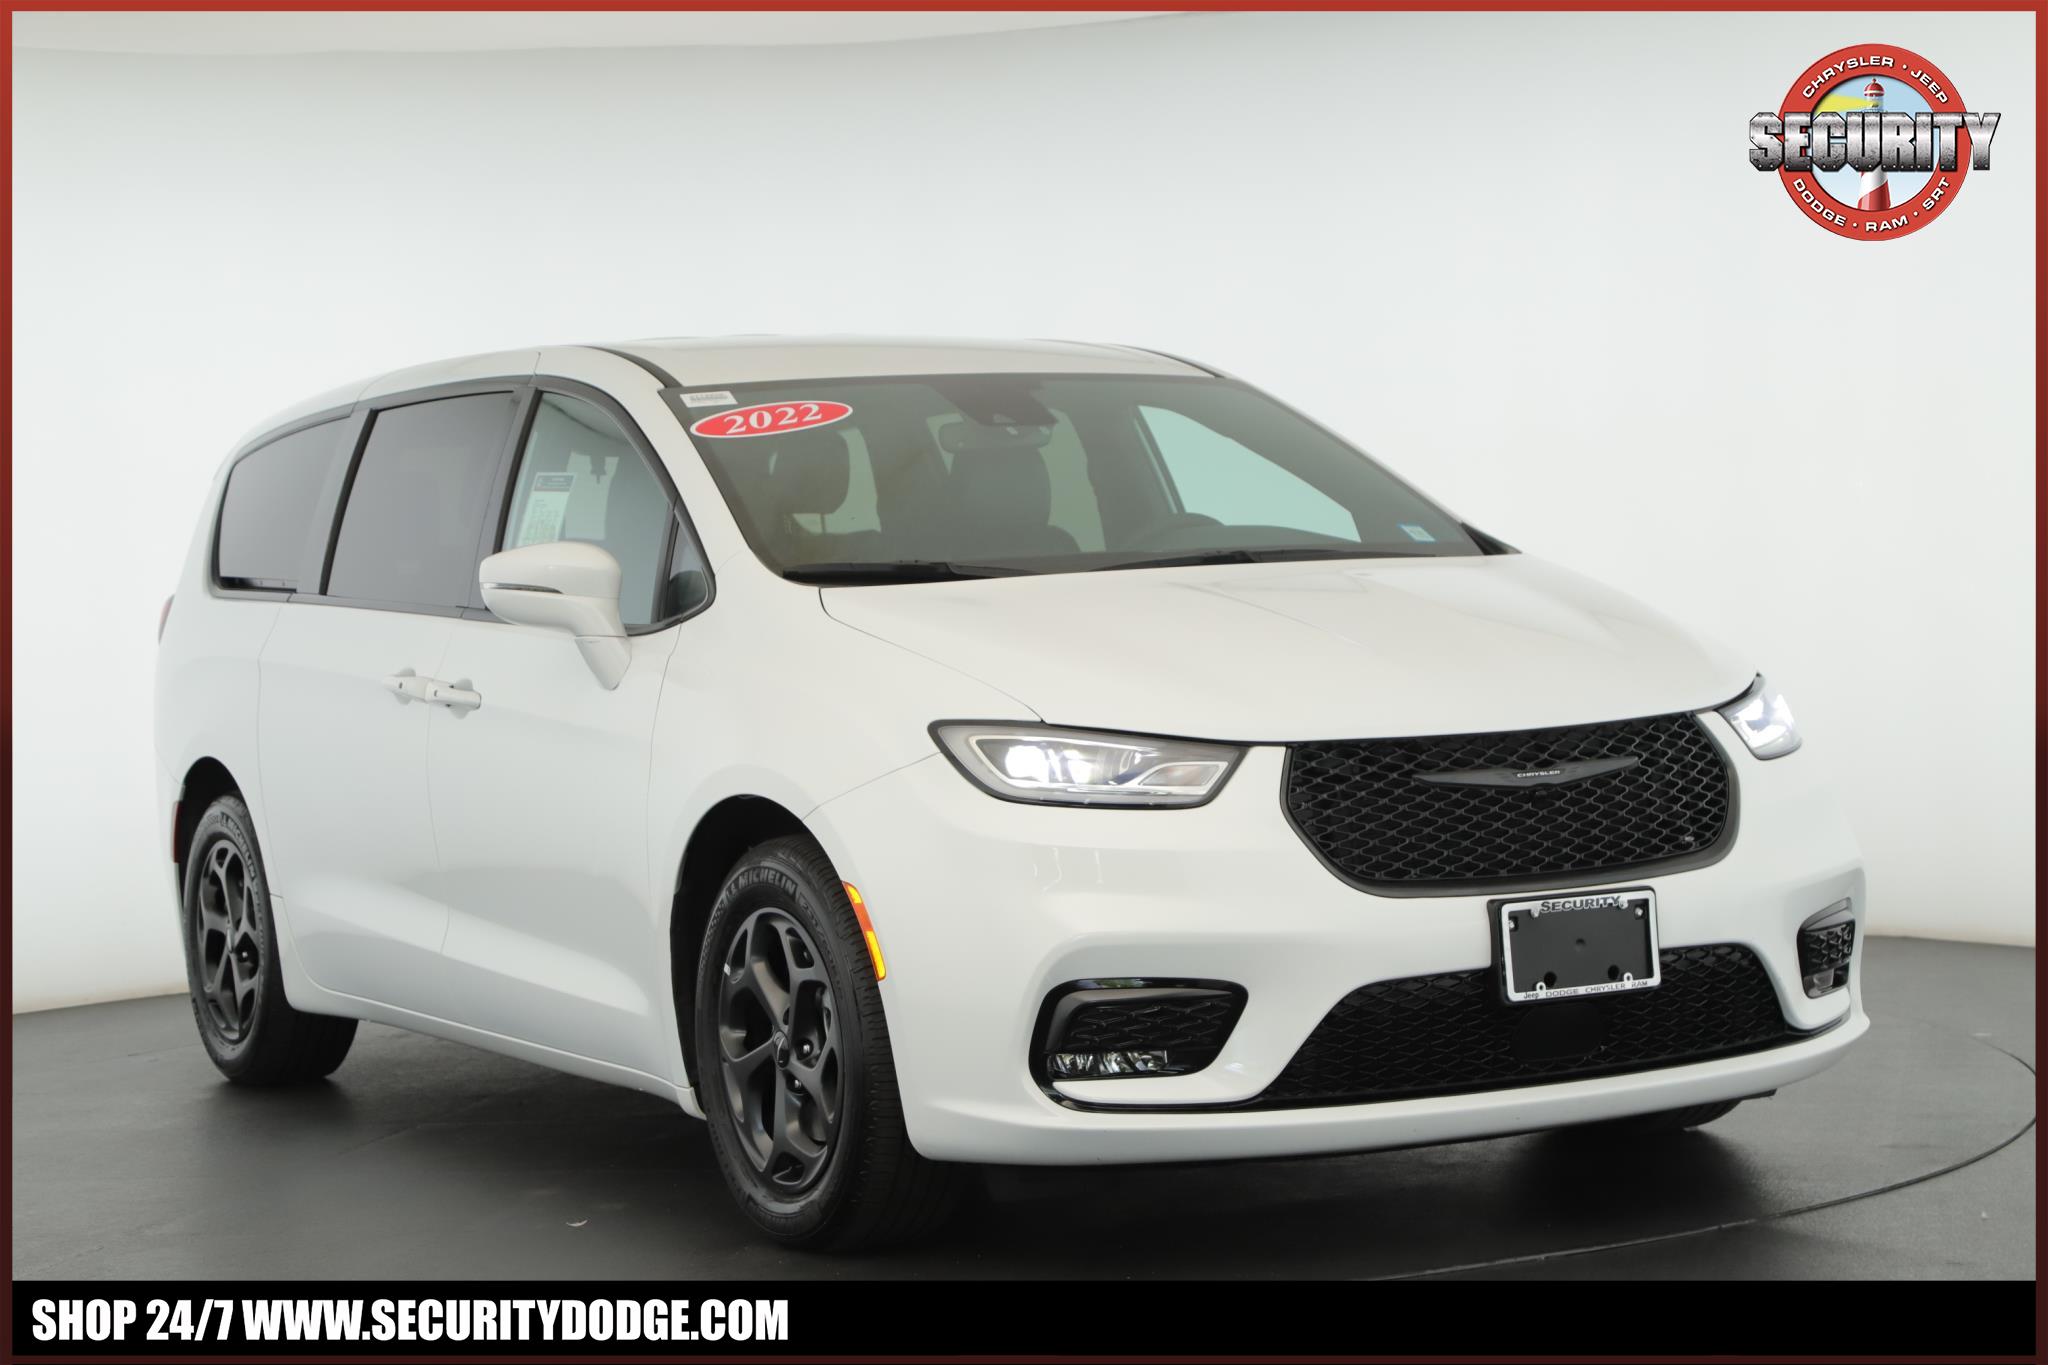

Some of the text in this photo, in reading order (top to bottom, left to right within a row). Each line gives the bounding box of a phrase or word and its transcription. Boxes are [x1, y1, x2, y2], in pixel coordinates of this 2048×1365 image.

[723, 403, 823, 435] 2022
[1516, 769, 1561, 778] CHRYSLER
[738, 867, 798, 897] MICHELIN
[1540, 895, 1622, 914] SECURITY
[1523, 980, 1648, 1000] Jeep DODGE CHRYSLER RAM
